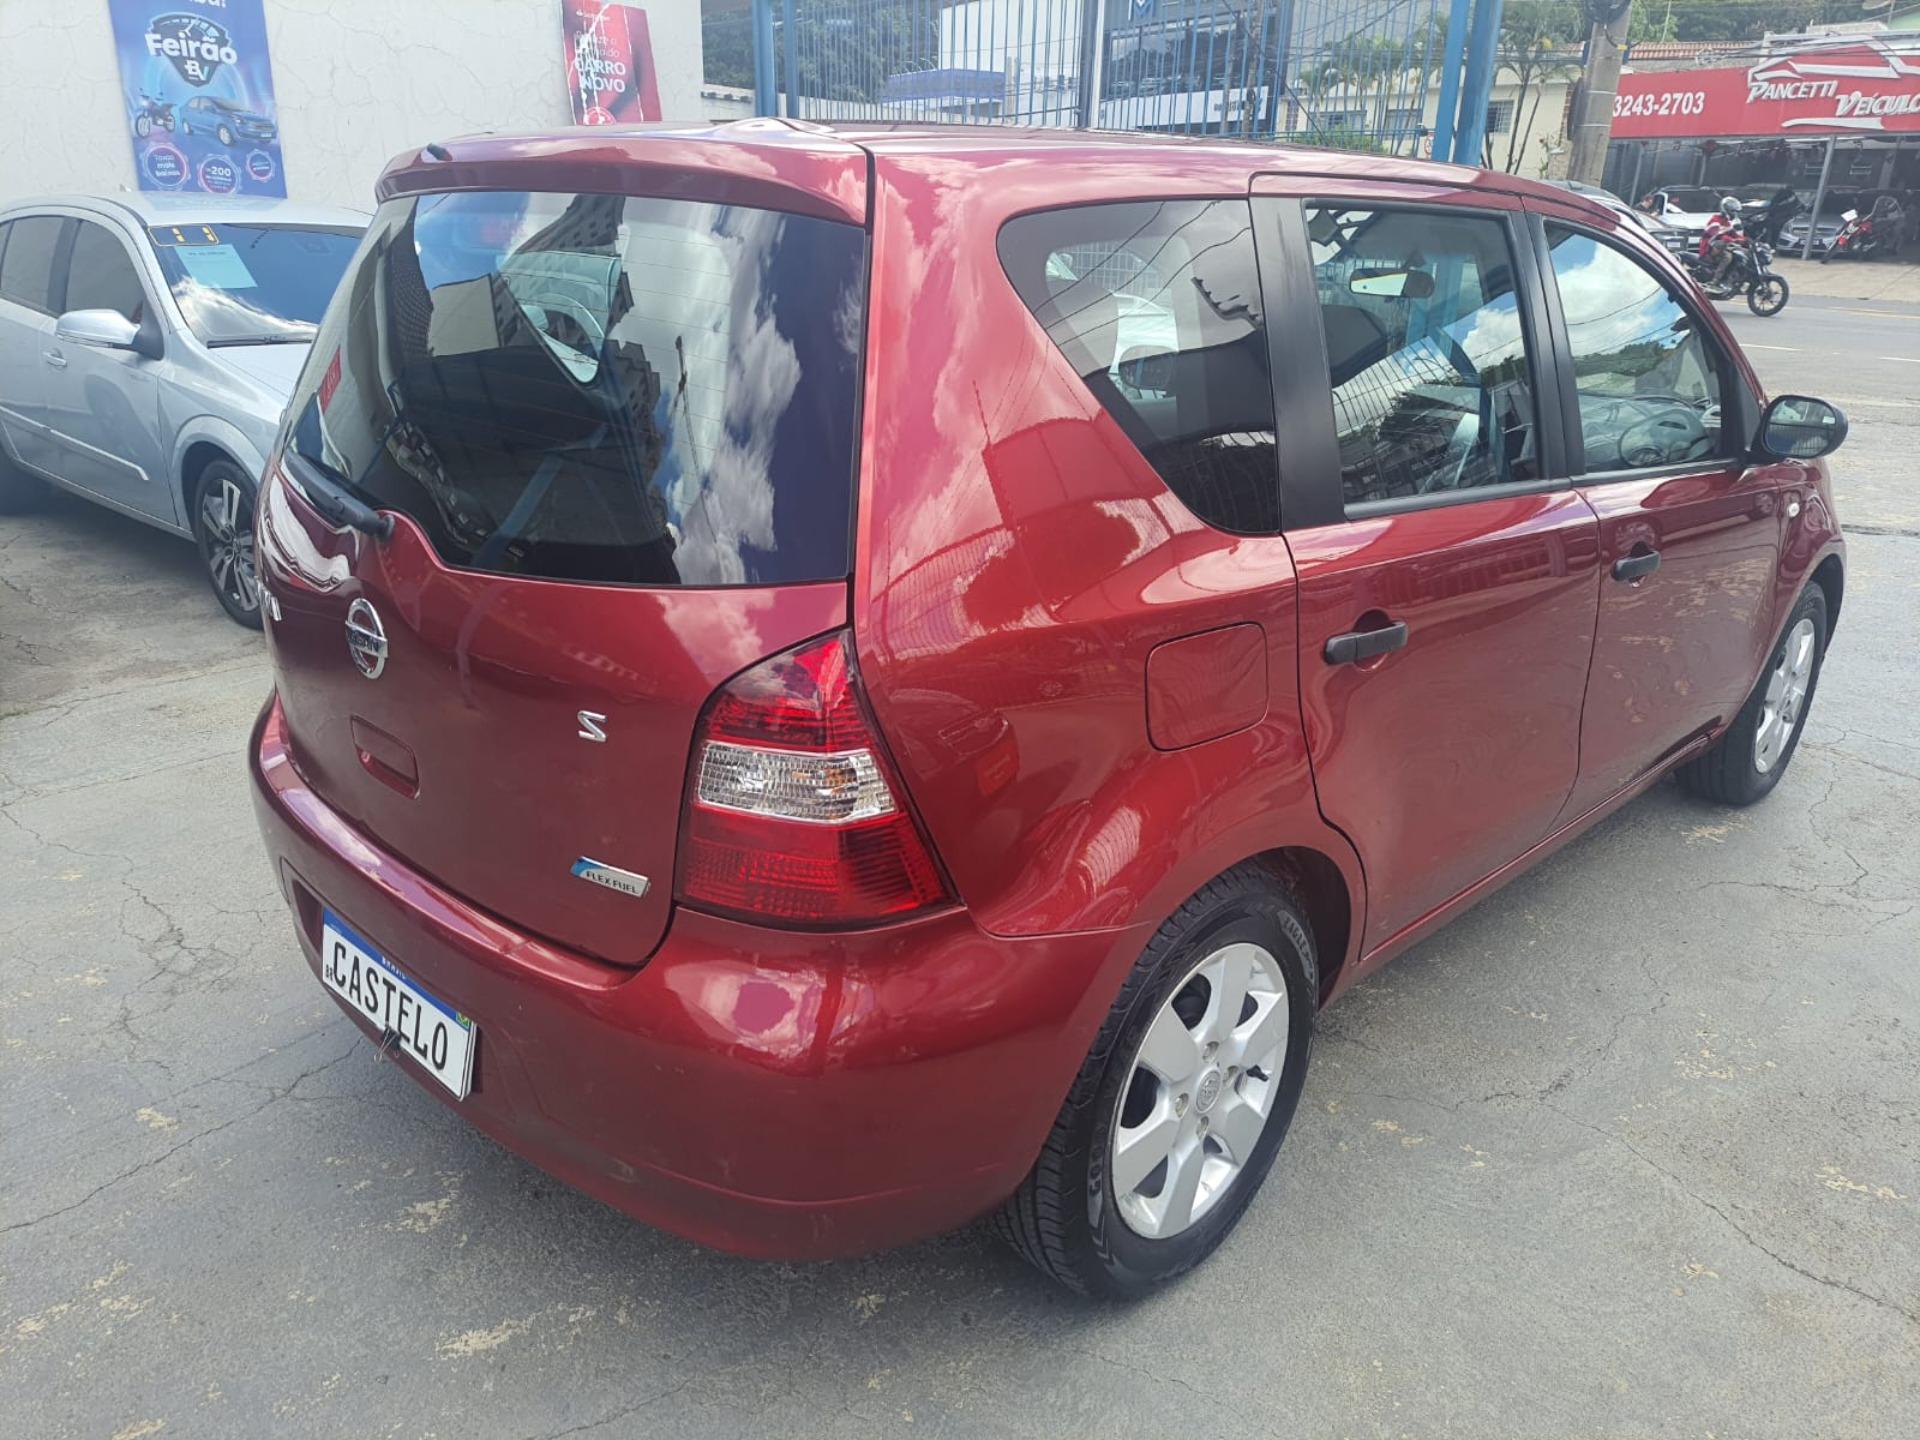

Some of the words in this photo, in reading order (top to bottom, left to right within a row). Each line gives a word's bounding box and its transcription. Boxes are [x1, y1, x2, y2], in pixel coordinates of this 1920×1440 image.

[144, 32, 238, 65] Feirão
[581, 76, 626, 93] NOVO
[1746, 80, 1838, 104] PANCETTI
[1612, 91, 1705, 118] 3243-2703
[211, 166, 232, 177] 200
[577, 710, 607, 742] S
[586, 870, 611, 885] FLEX
[612, 880, 638, 895] FUEL
[333, 941, 449, 1071] CASTELO
